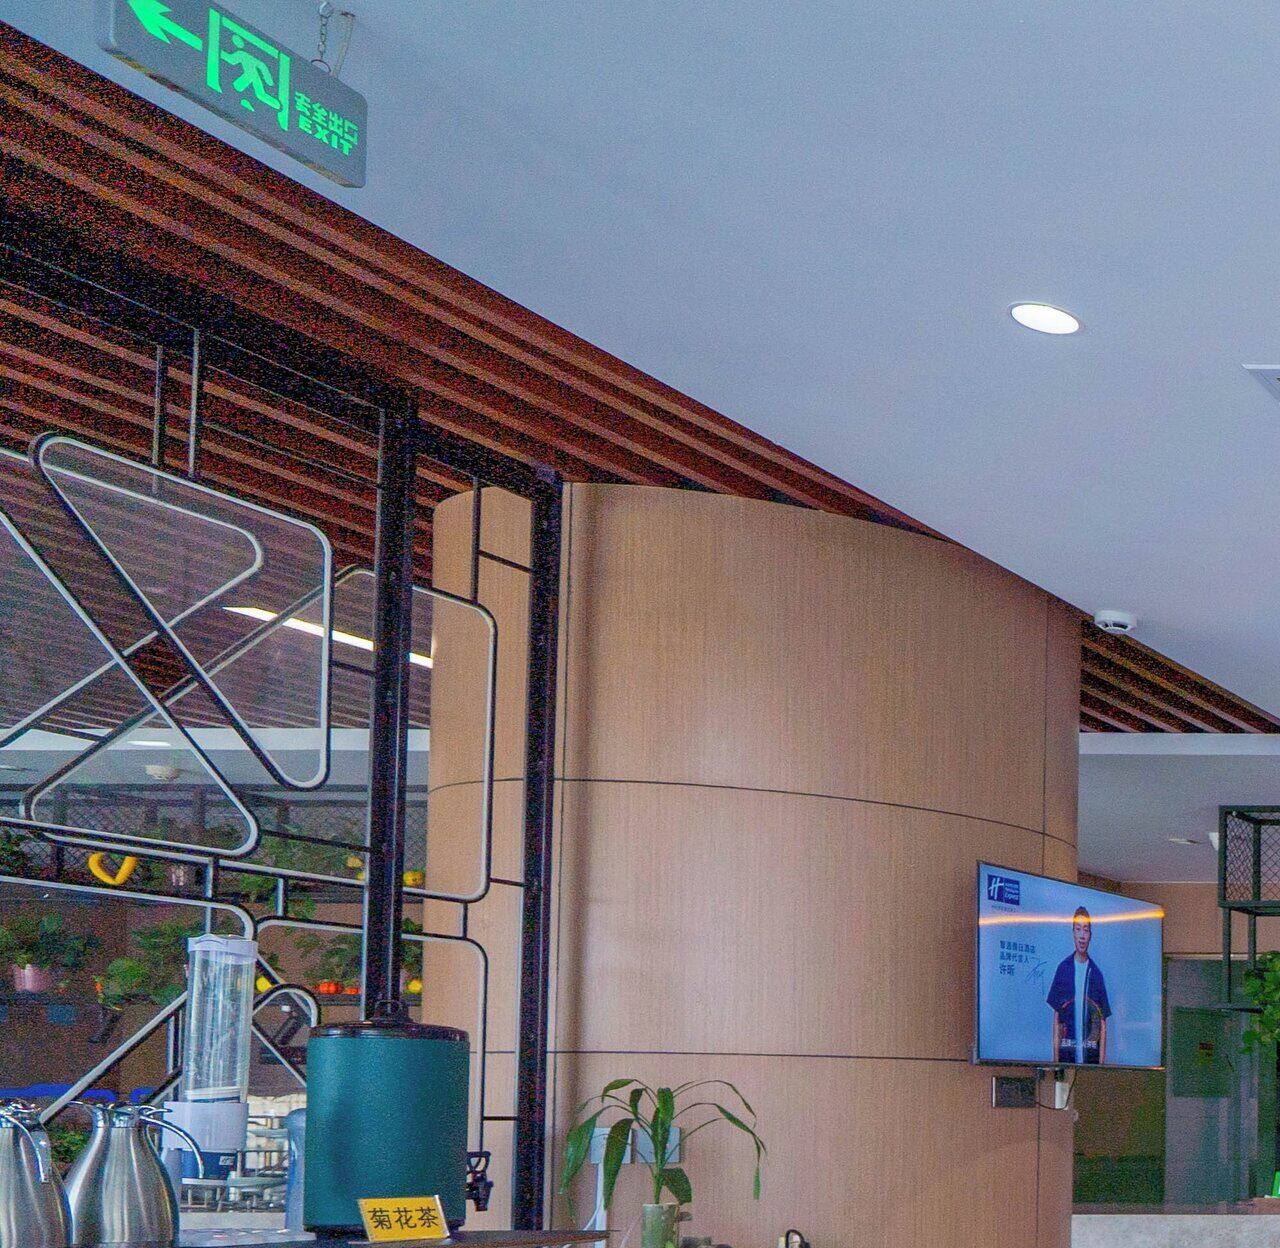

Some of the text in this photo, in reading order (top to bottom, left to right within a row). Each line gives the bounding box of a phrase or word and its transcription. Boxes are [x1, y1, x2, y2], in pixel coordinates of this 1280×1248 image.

[295, 91, 359, 145] 安全出口
[298, 114, 353, 156] EXIT
[367, 1206, 439, 1230] 菊花茶
